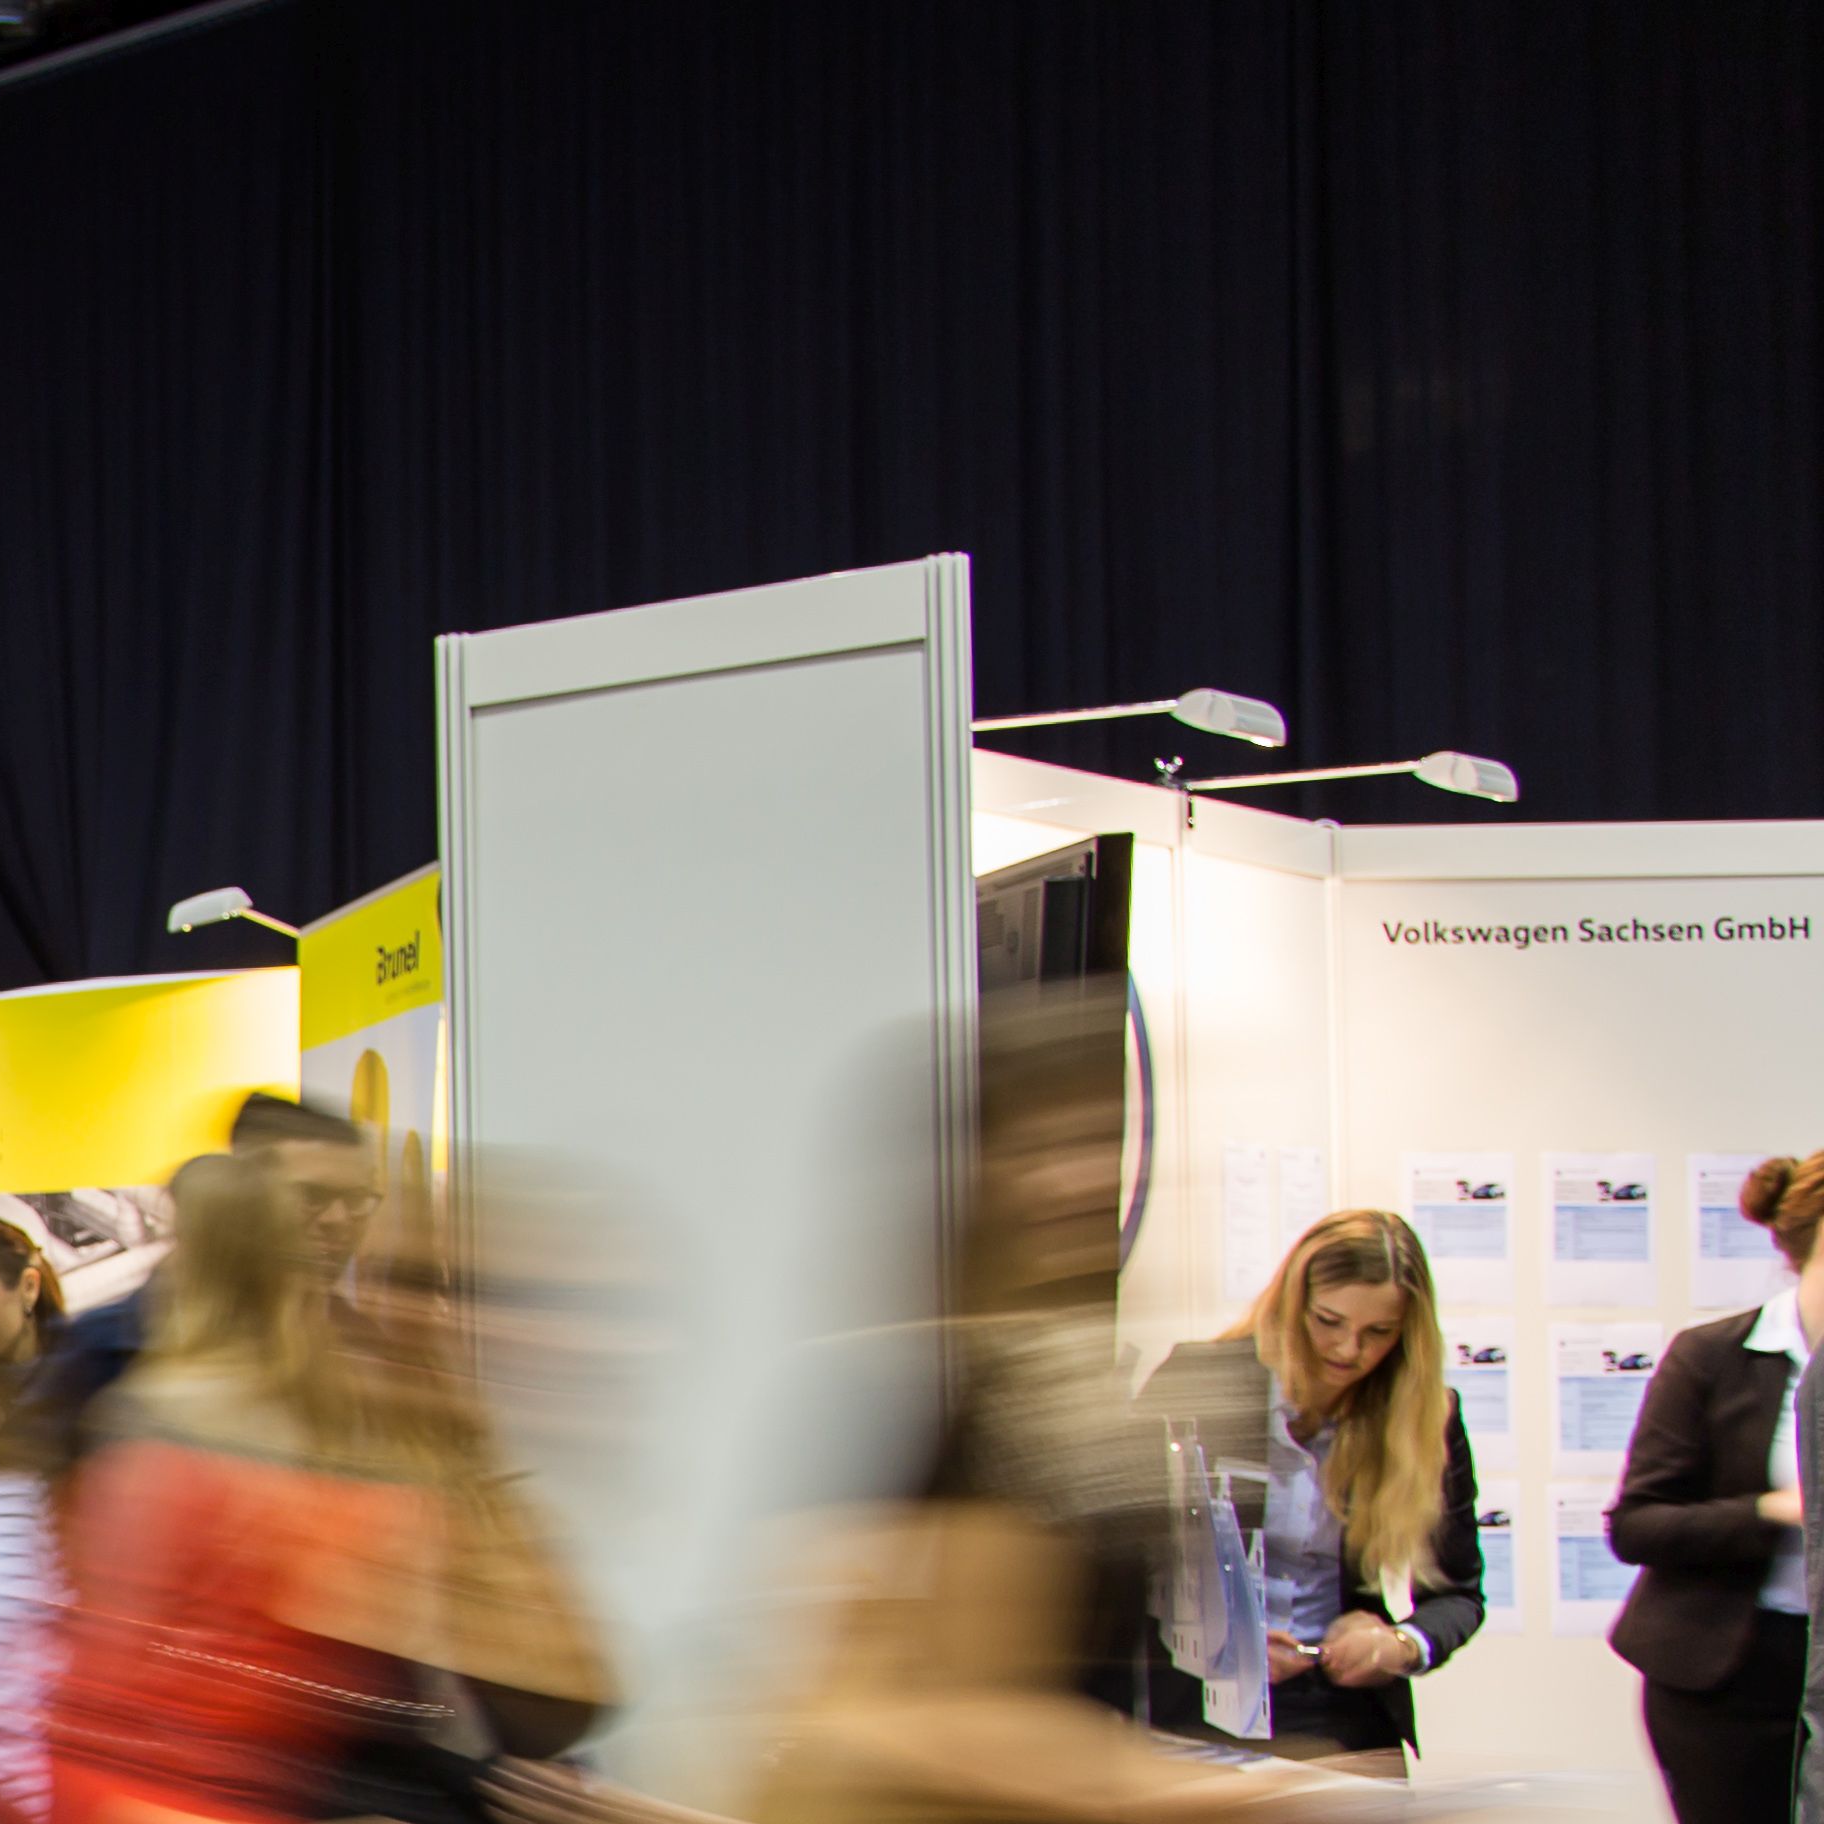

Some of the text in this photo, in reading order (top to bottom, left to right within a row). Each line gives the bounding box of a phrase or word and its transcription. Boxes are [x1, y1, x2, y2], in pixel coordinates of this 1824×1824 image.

[1382, 916, 1812, 949] Volkswagen Sachsen GmbH
[376, 928, 420, 987] Brunel
